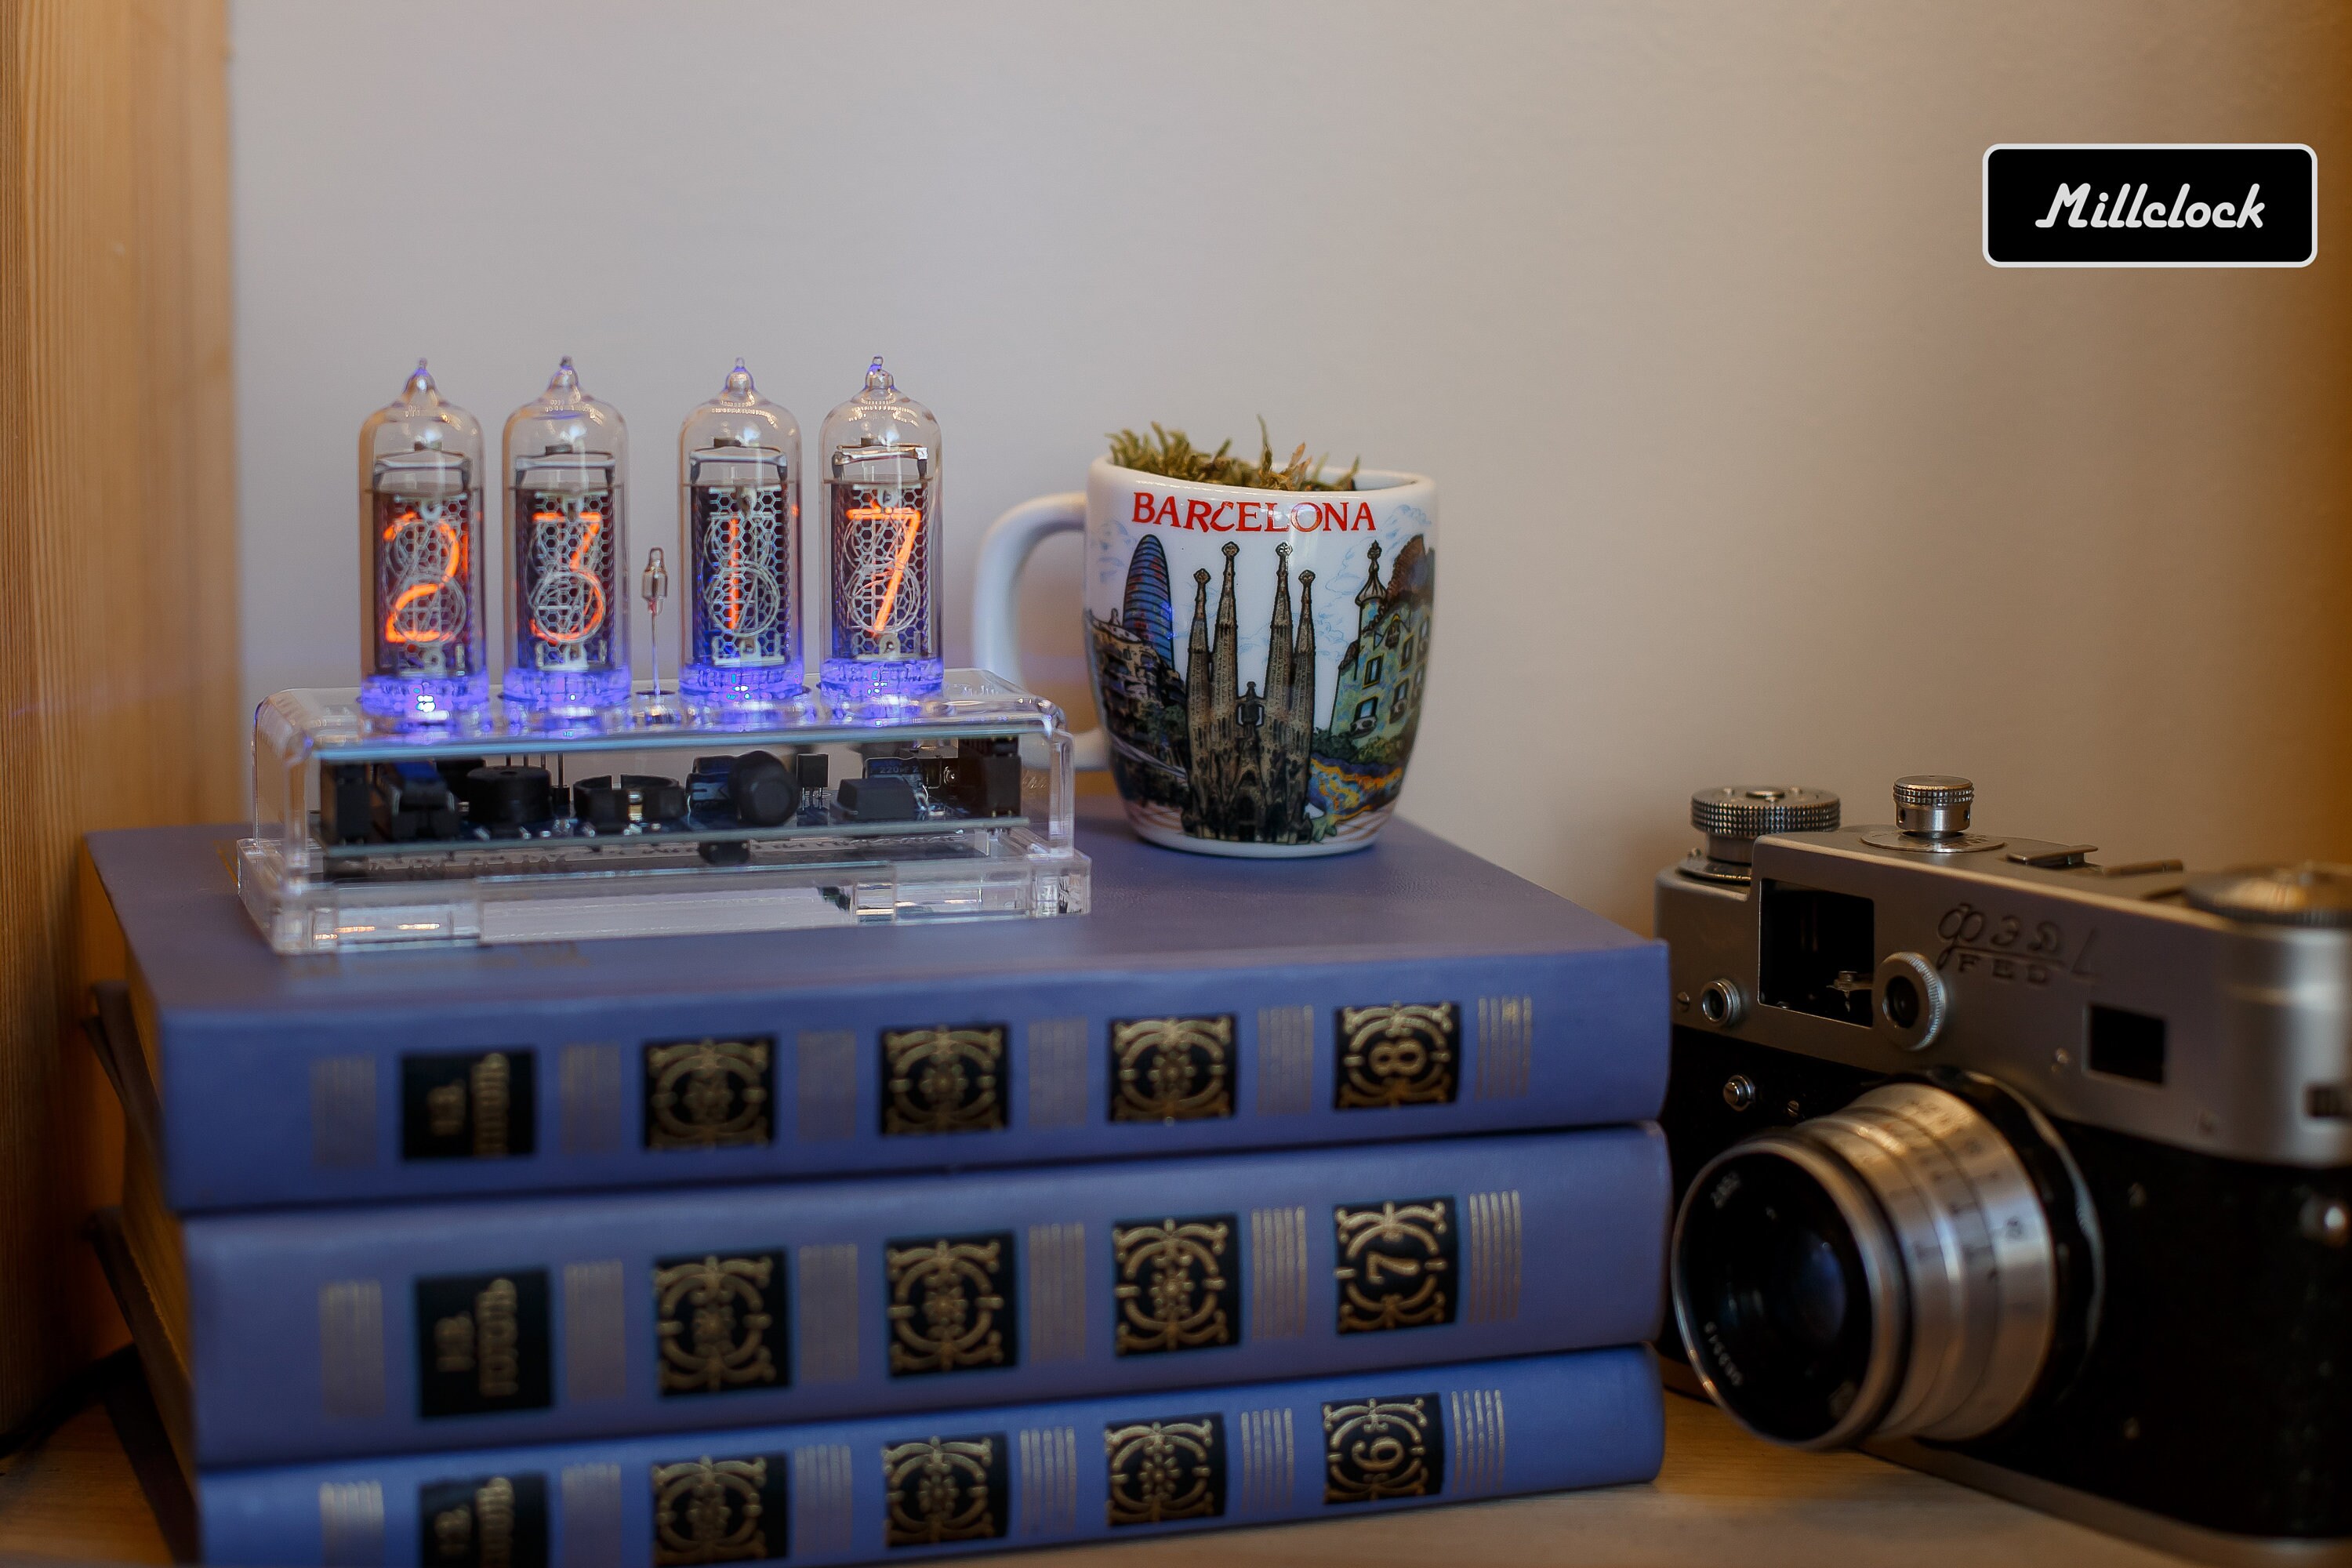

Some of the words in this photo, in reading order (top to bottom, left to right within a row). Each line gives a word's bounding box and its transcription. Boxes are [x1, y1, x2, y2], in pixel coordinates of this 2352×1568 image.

[1132, 492, 1376, 532] BARCELONA
[1369, 1039, 1426, 1077] 8
[1367, 1252, 1420, 1284] 7
